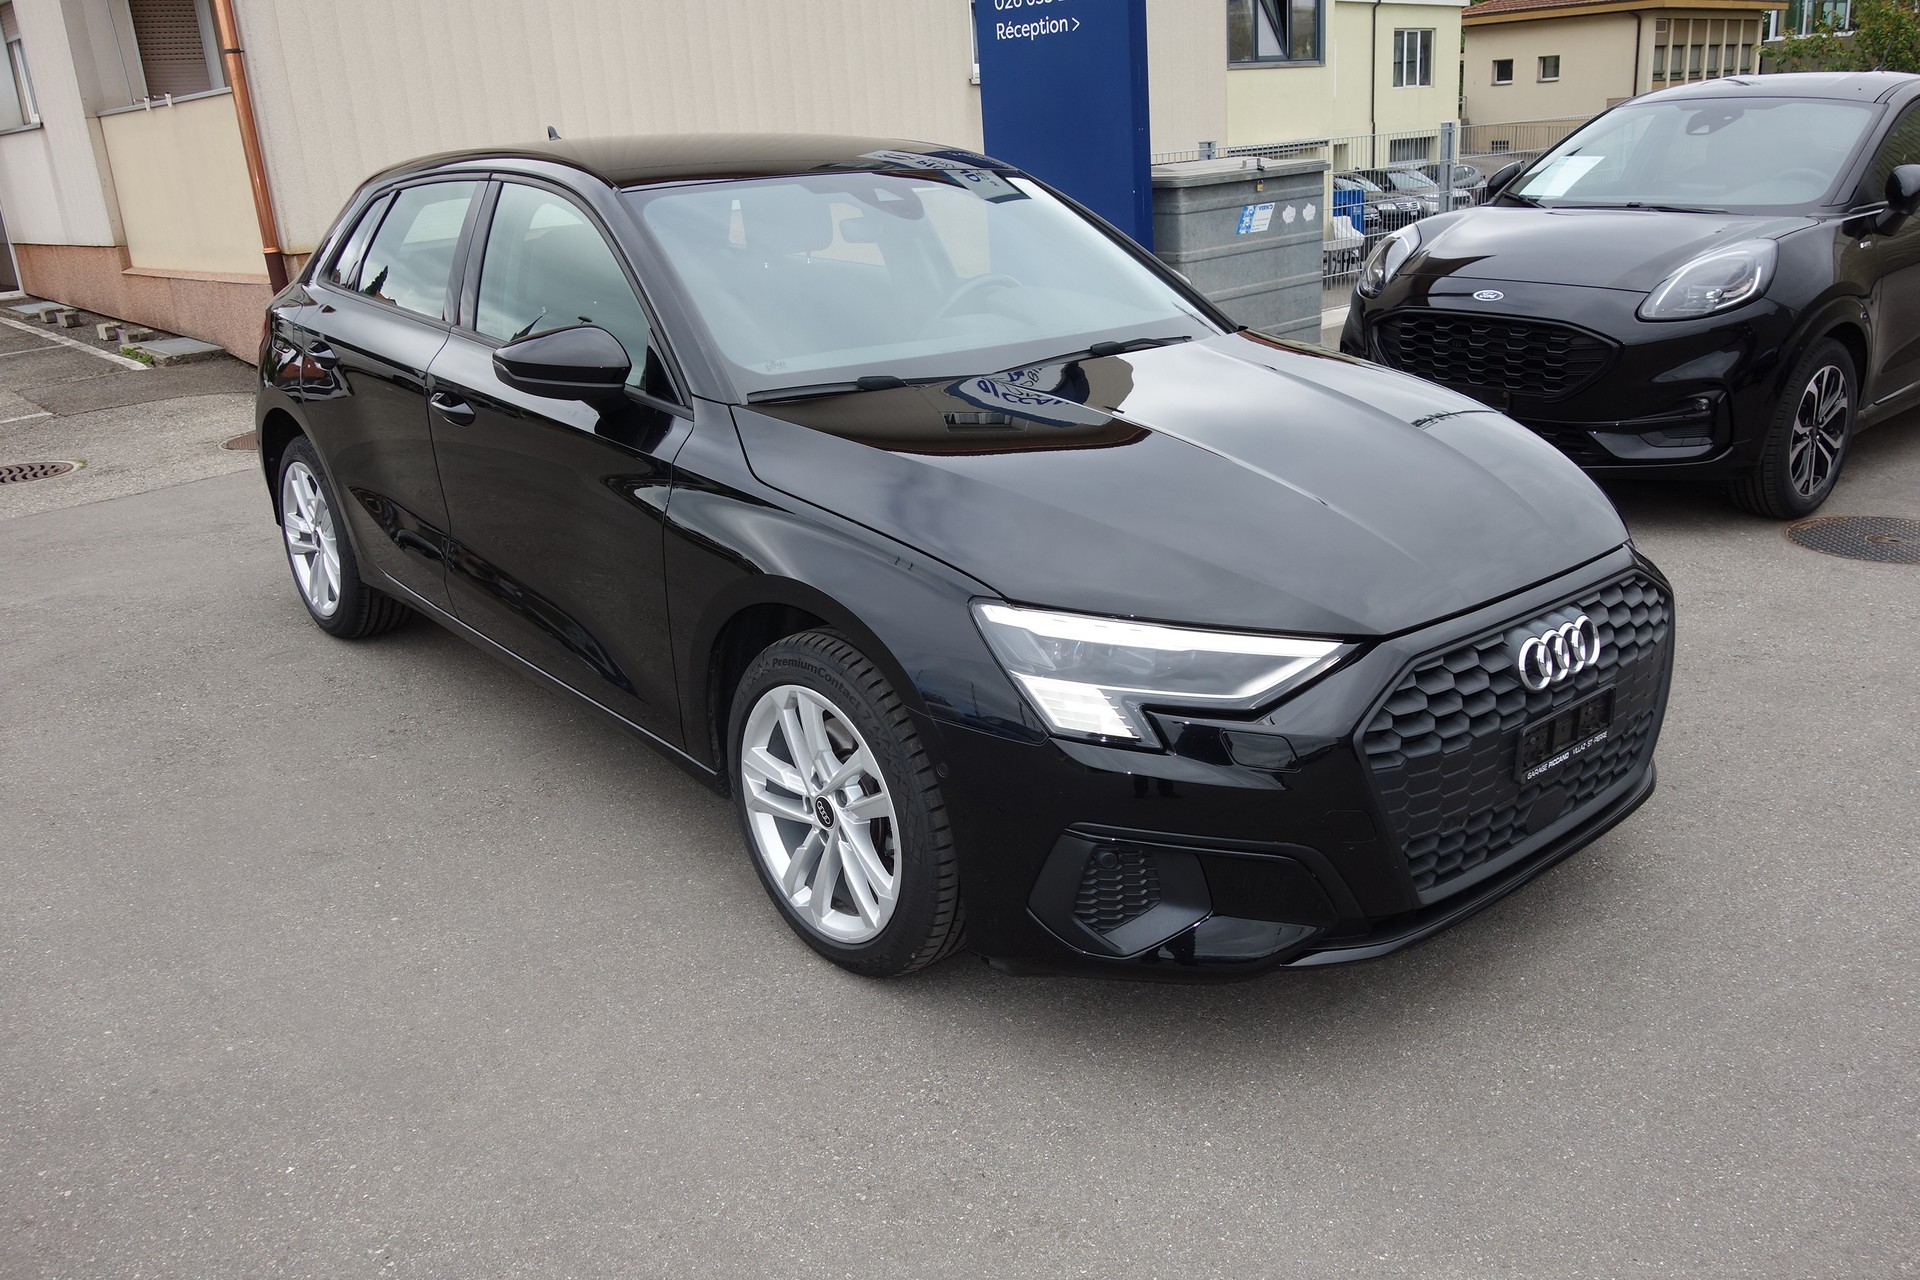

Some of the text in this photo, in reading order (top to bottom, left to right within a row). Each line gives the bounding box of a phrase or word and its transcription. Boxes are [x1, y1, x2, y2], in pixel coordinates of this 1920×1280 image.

[996, 15, 1069, 41] Réception
[1478, 291, 1499, 300] Ford
[772, 657, 862, 710] PremiumContact
[1527, 764, 1548, 780] GARAGE
[1548, 751, 1570, 769] PICCAND
